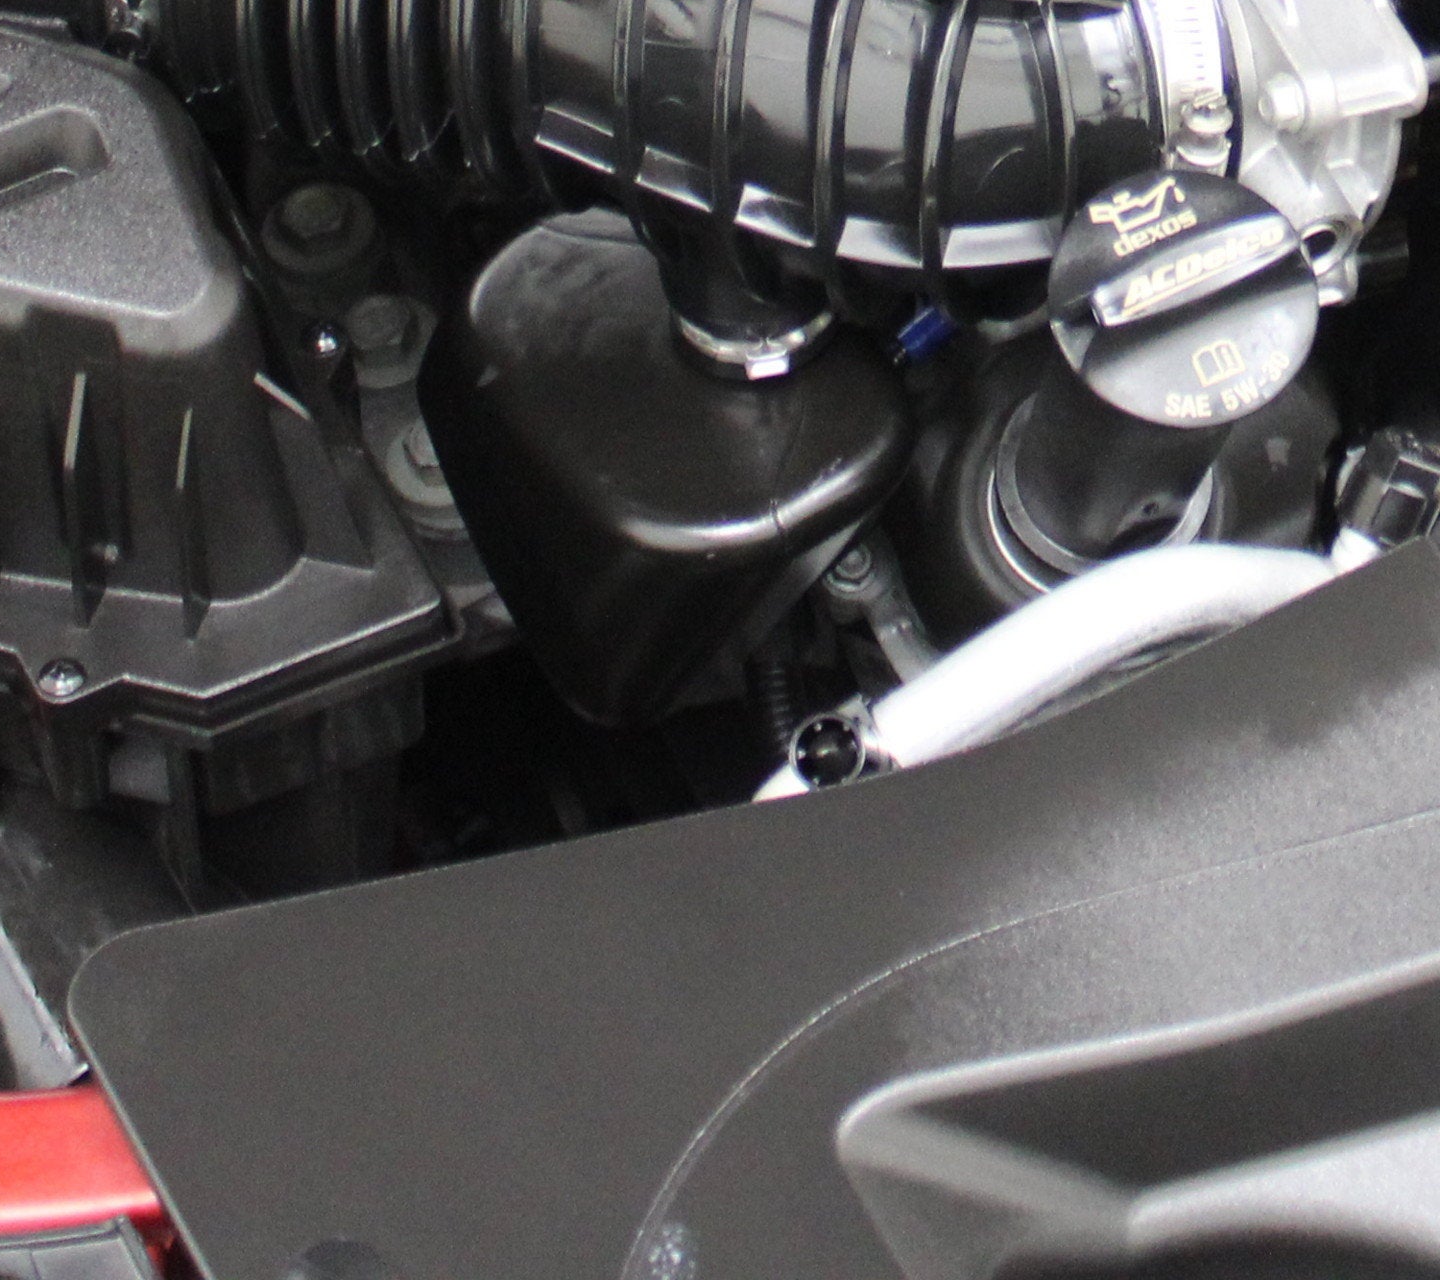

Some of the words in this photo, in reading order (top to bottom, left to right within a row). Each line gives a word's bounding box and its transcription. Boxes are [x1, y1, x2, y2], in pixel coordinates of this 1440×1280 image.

[1113, 208, 1198, 258] dexos
[1123, 224, 1285, 309] ACDelco
[1164, 391, 1213, 419] SAE
[1220, 349, 1291, 413] 5W-30
